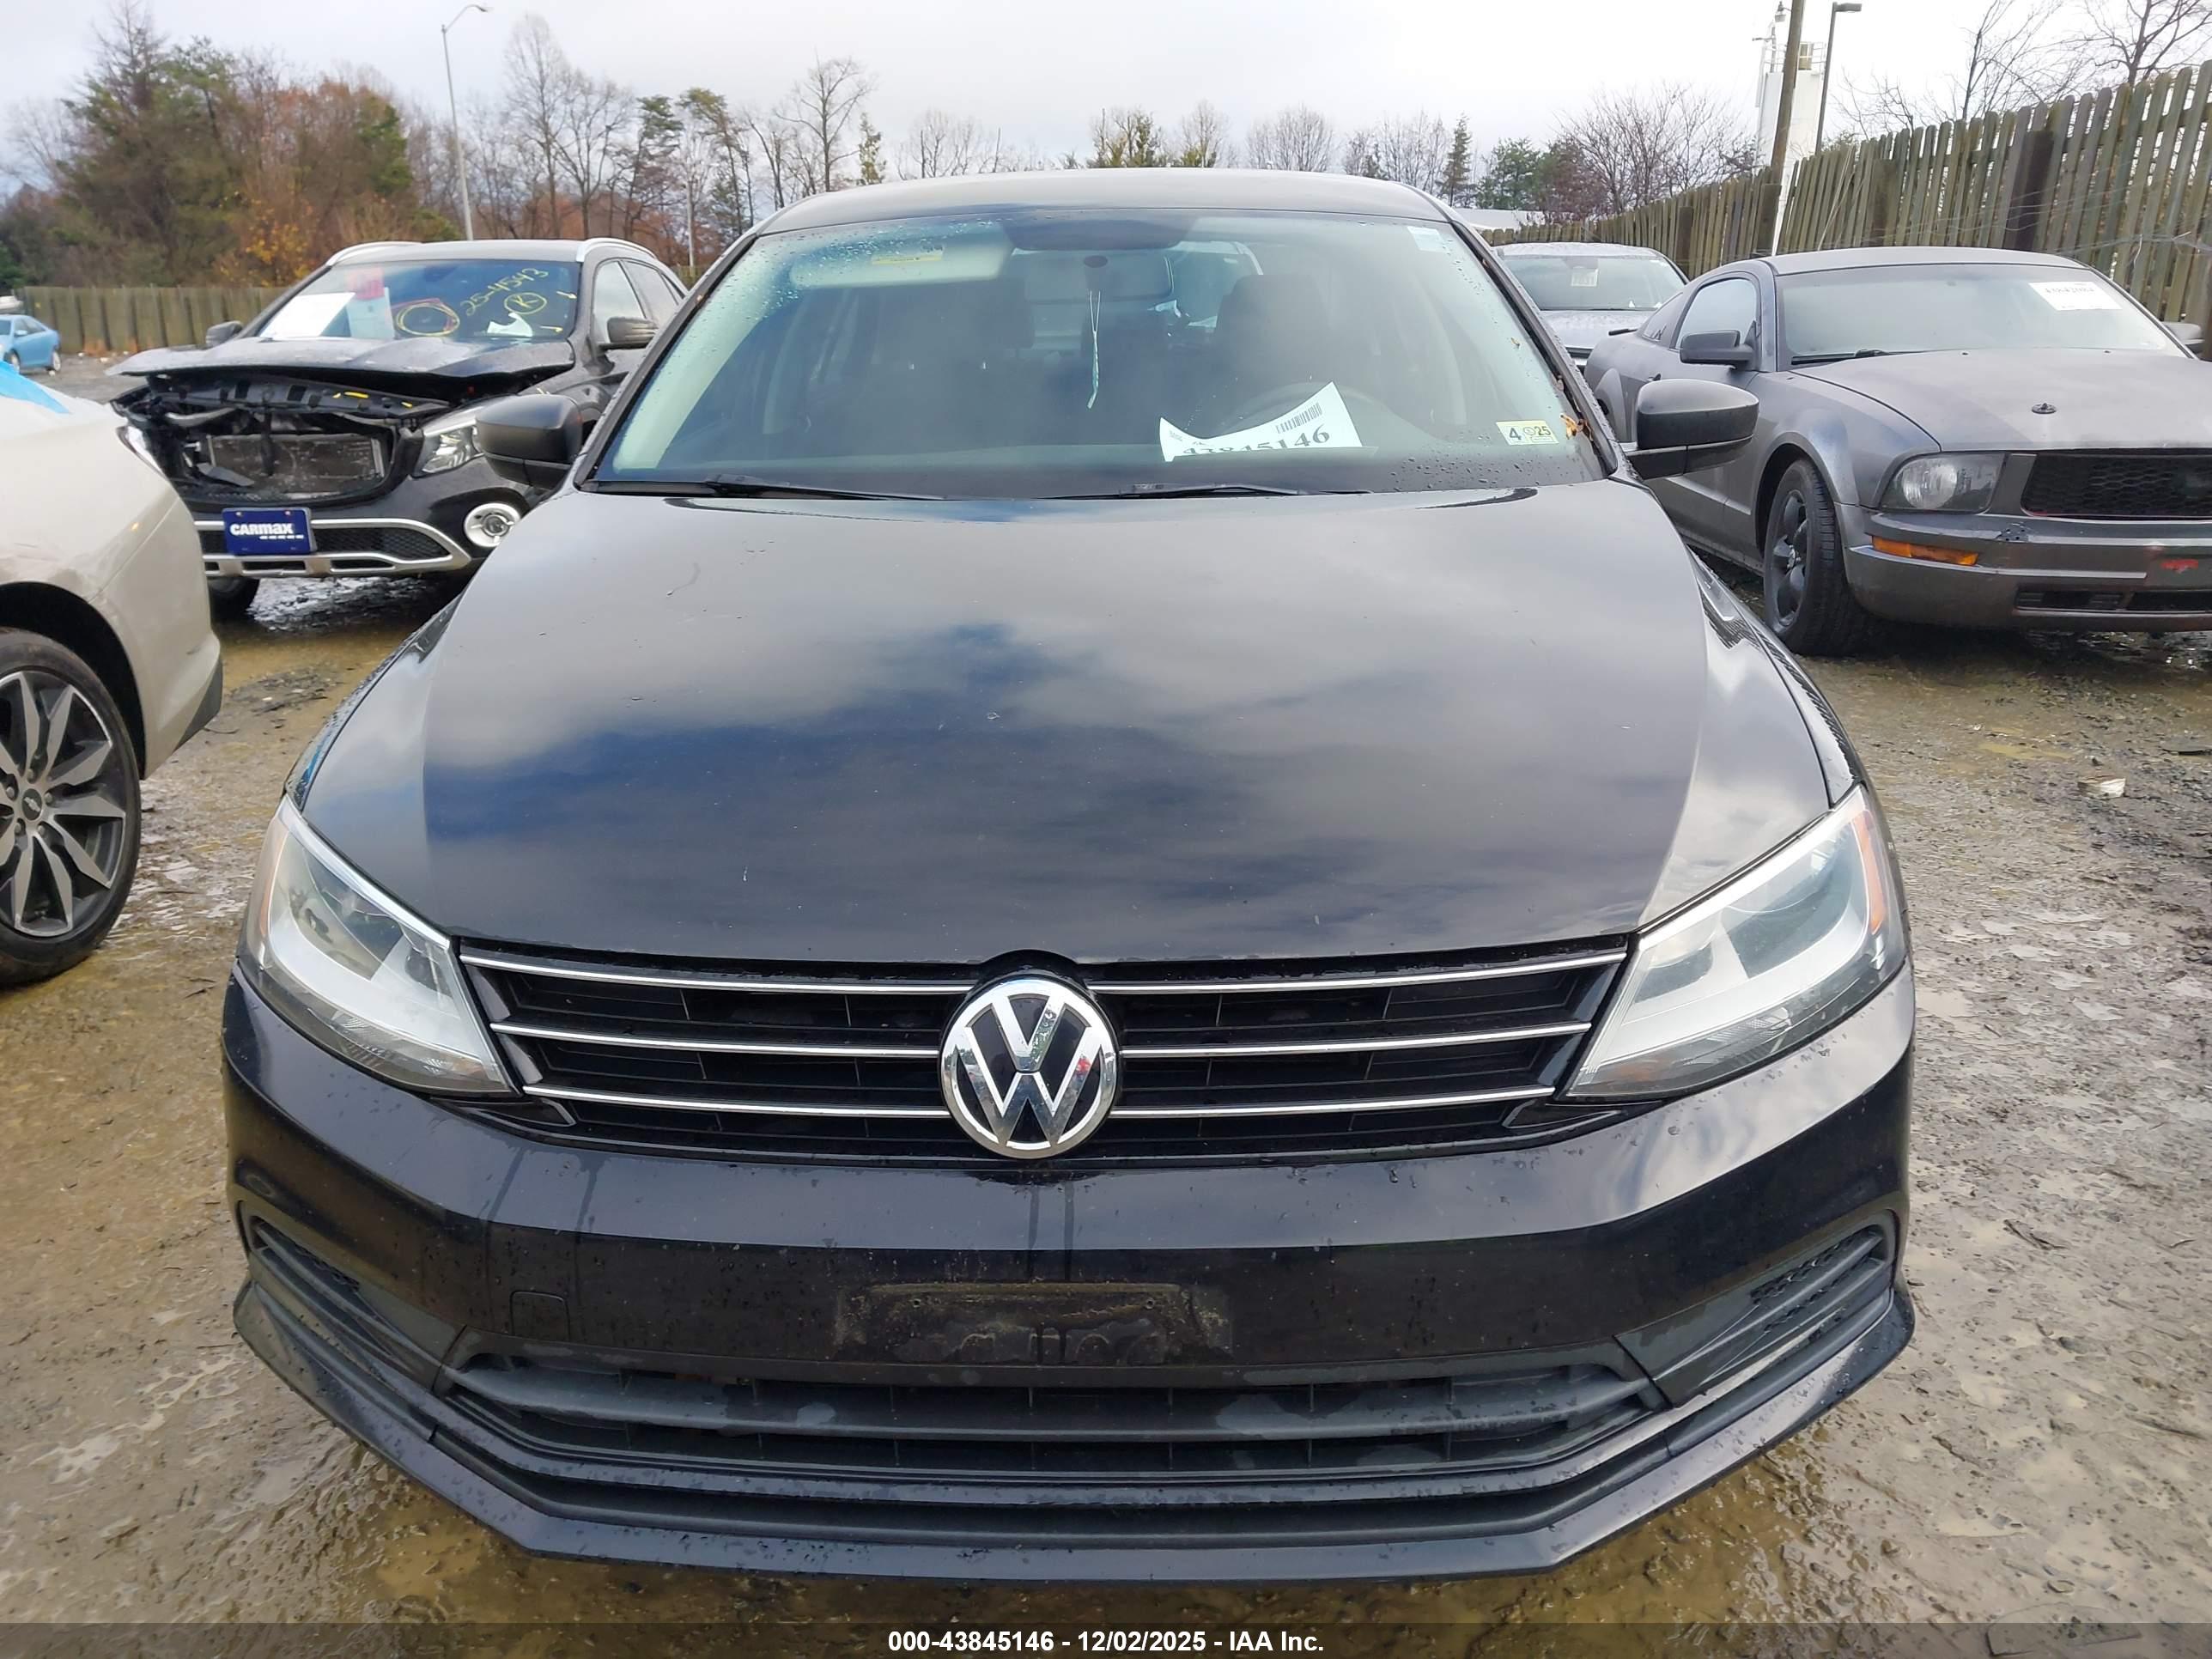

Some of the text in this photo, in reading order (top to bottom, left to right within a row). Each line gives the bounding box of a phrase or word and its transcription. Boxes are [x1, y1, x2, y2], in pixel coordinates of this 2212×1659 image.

[1509, 427, 1522, 441] 4
[1534, 425, 1552, 436] 25
[947, 984, 1111, 1154] VW
